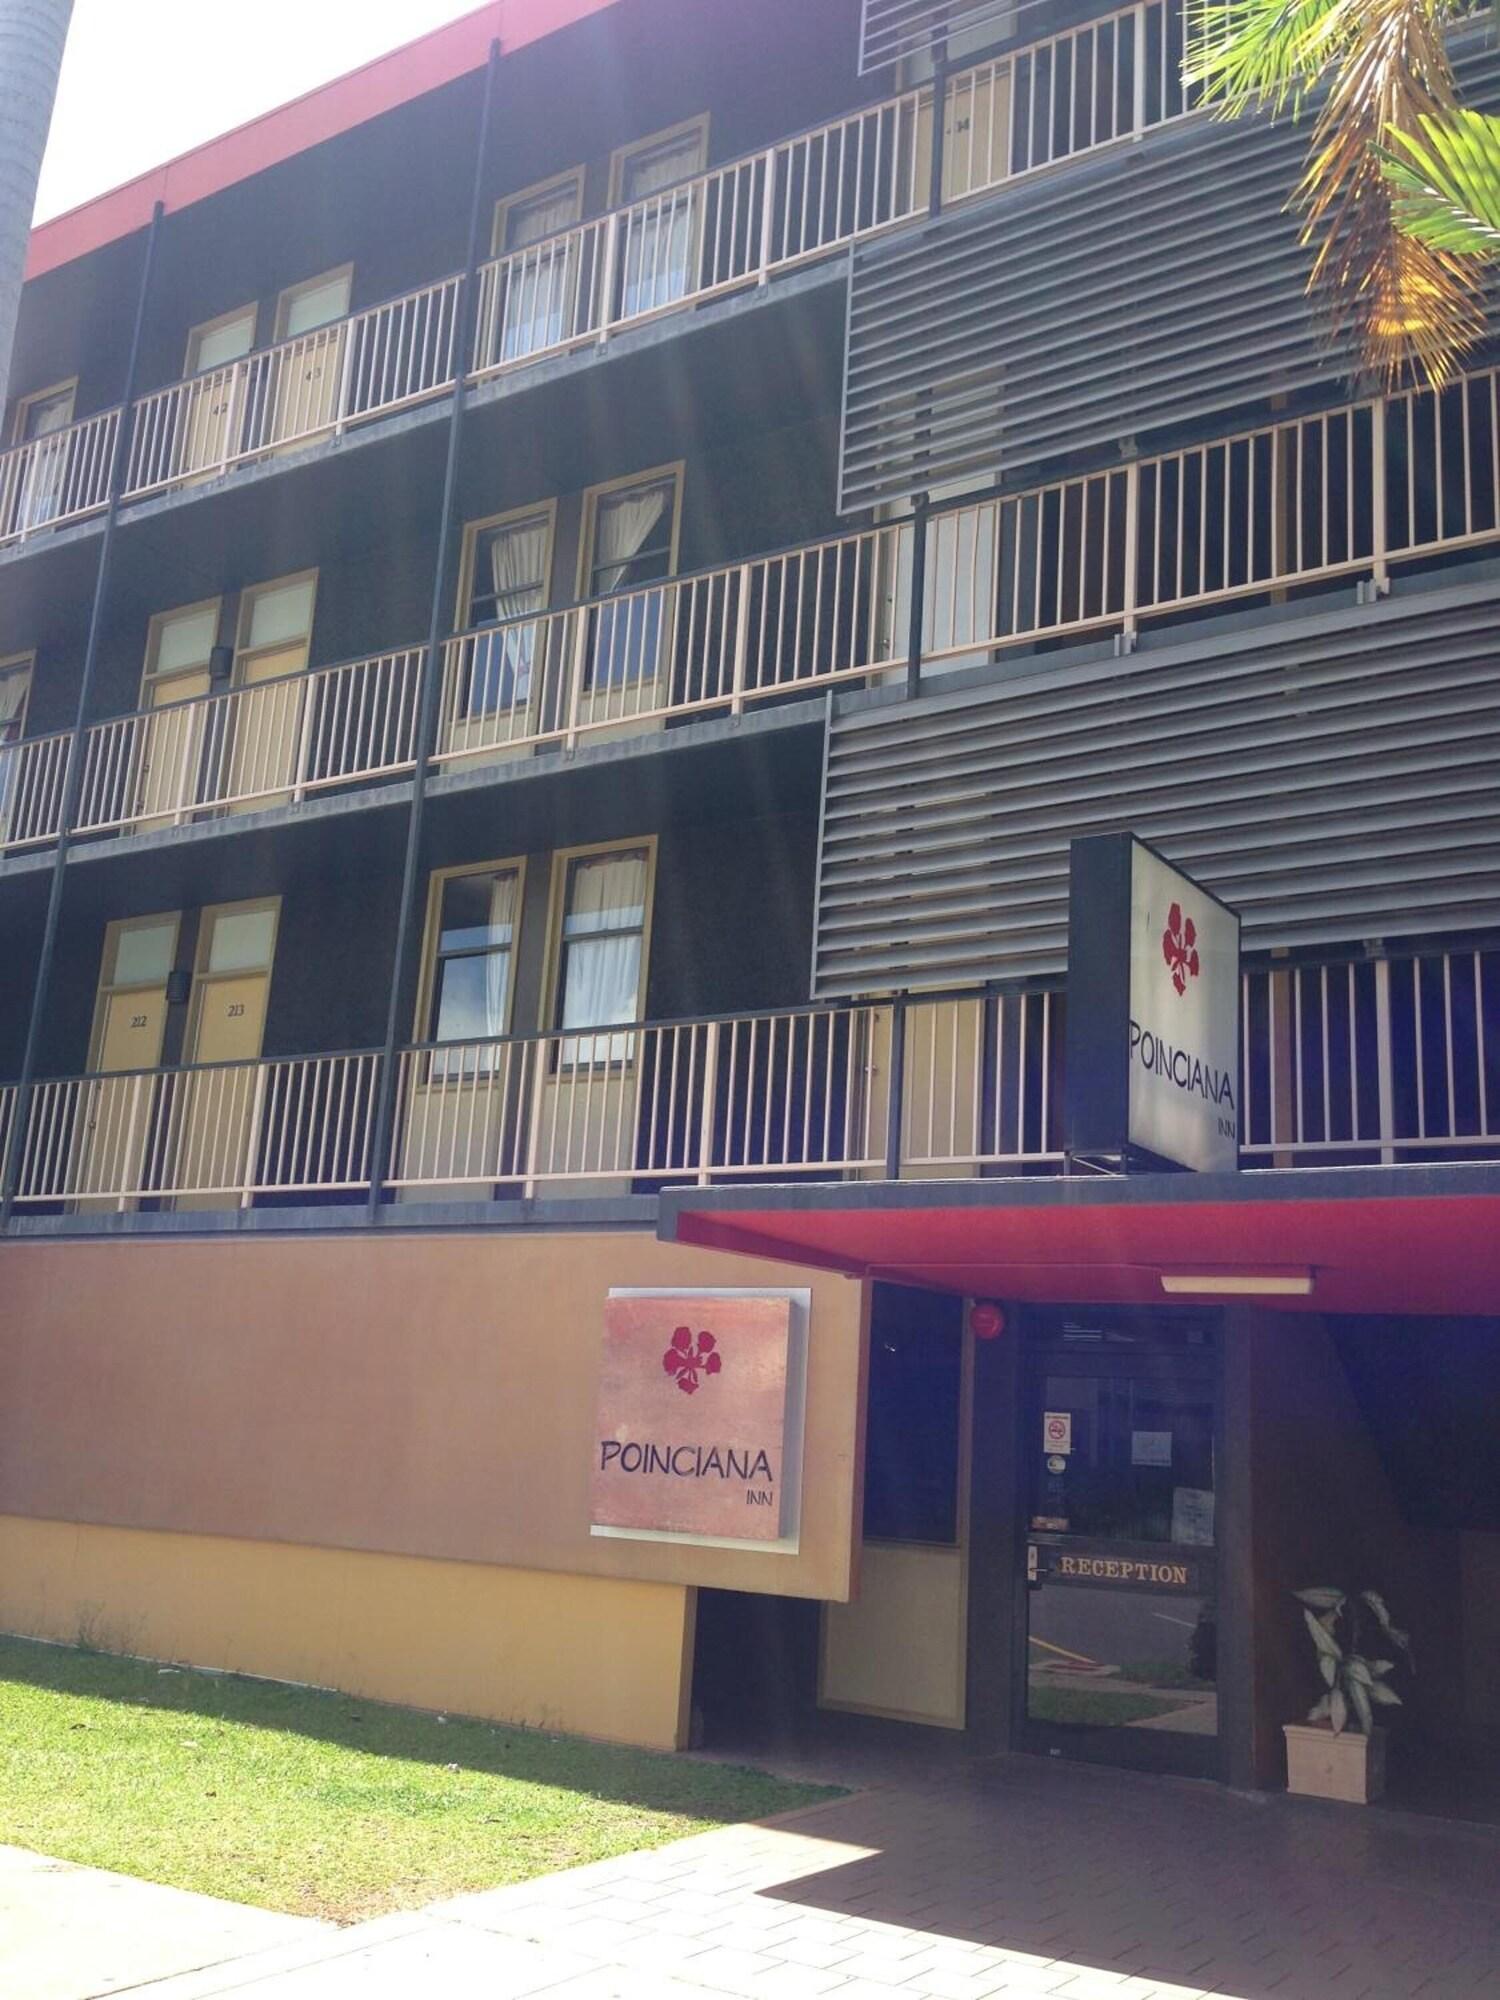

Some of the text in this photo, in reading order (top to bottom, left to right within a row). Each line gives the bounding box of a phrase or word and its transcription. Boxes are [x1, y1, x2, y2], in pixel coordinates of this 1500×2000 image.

[305, 367, 321, 381] 43
[212, 402, 228, 415] 42
[228, 1003, 245, 1017] 213
[130, 1015, 147, 1028] 212
[1130, 1020, 1235, 1110] POINCIANA
[1217, 1117, 1236, 1140] INN
[600, 1440, 773, 1482] POINCIANA
[746, 1489, 773, 1507] INN
[1060, 1556, 1188, 1584] RECEPTION
